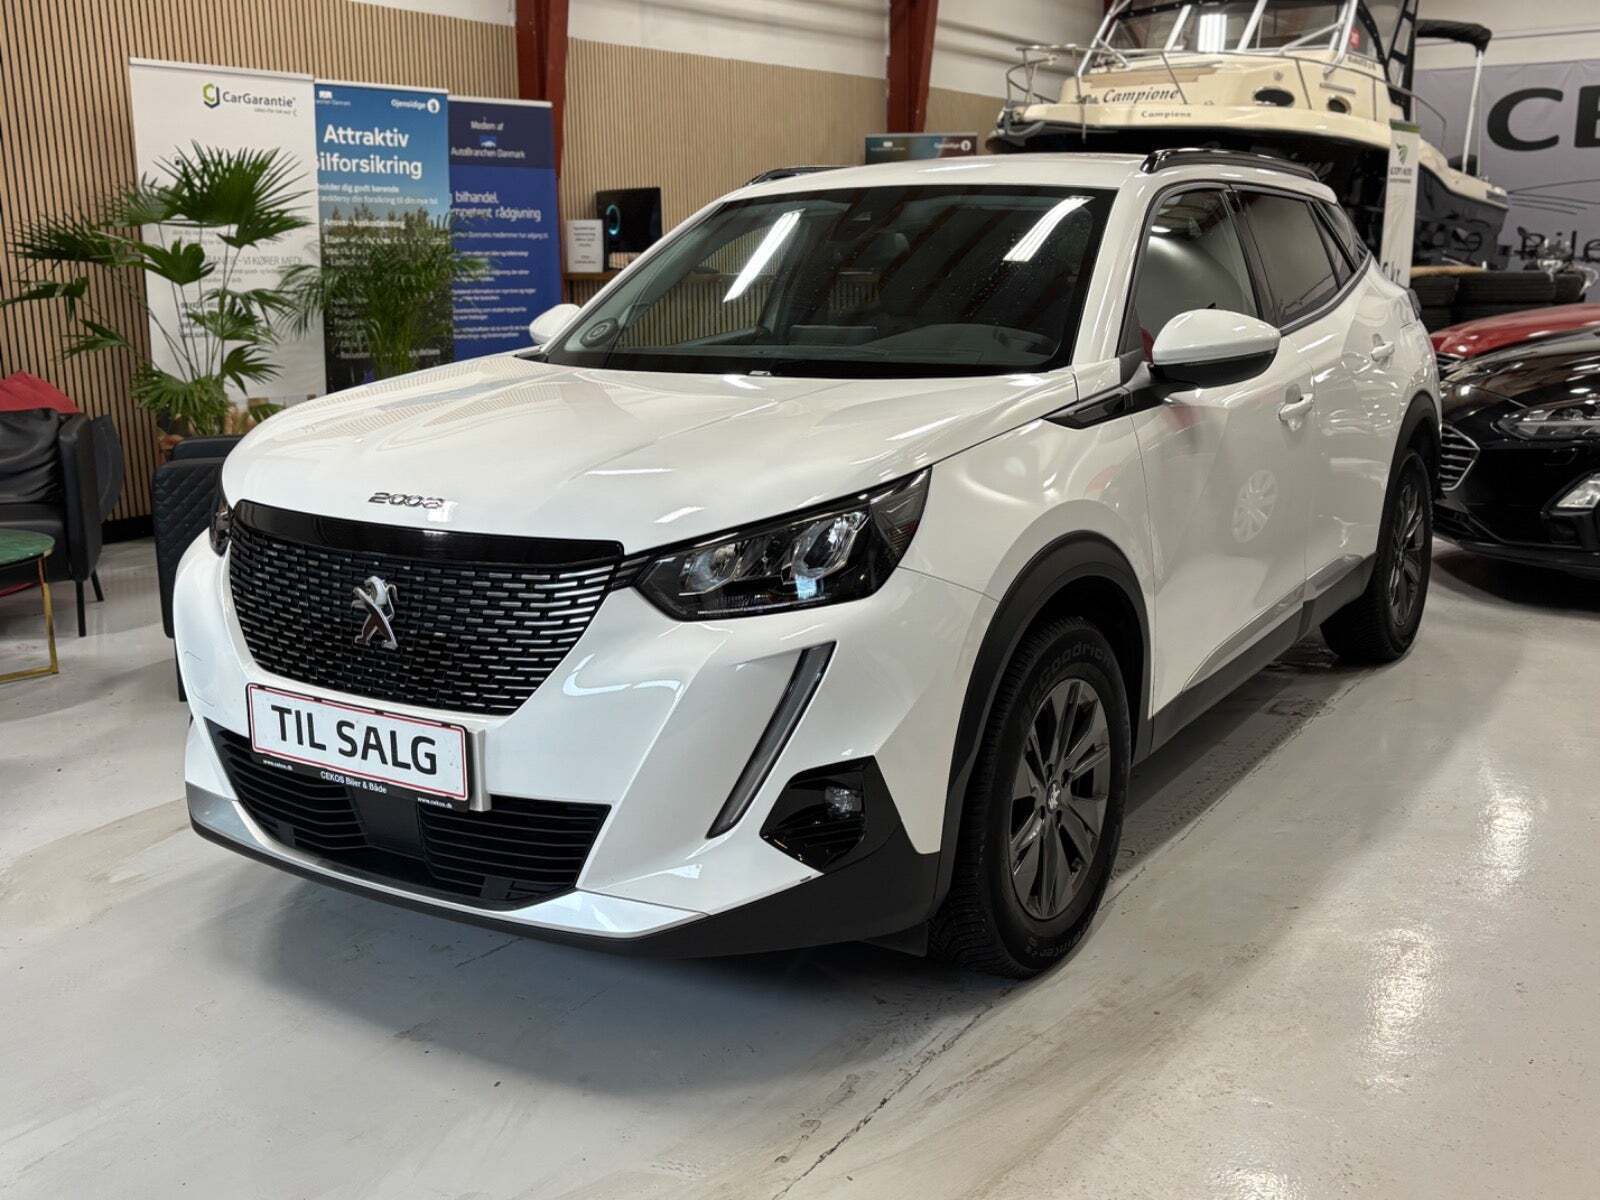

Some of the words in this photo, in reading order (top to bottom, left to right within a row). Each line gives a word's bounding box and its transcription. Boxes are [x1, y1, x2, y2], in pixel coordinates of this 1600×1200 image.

[222, 91, 293, 107] CarGarantie
[1103, 87, 1180, 103] Campione
[1141, 110, 1191, 118] Campione
[323, 124, 409, 147] Attraktiv
[495, 206, 542, 223] rådgivning
[271, 705, 327, 751] TIL
[336, 720, 437, 775] SALG
[320, 770, 345, 784] CEKOS
[345, 777, 361, 788] Biler
[362, 781, 368, 789] &
[368, 782, 388, 794] Både
